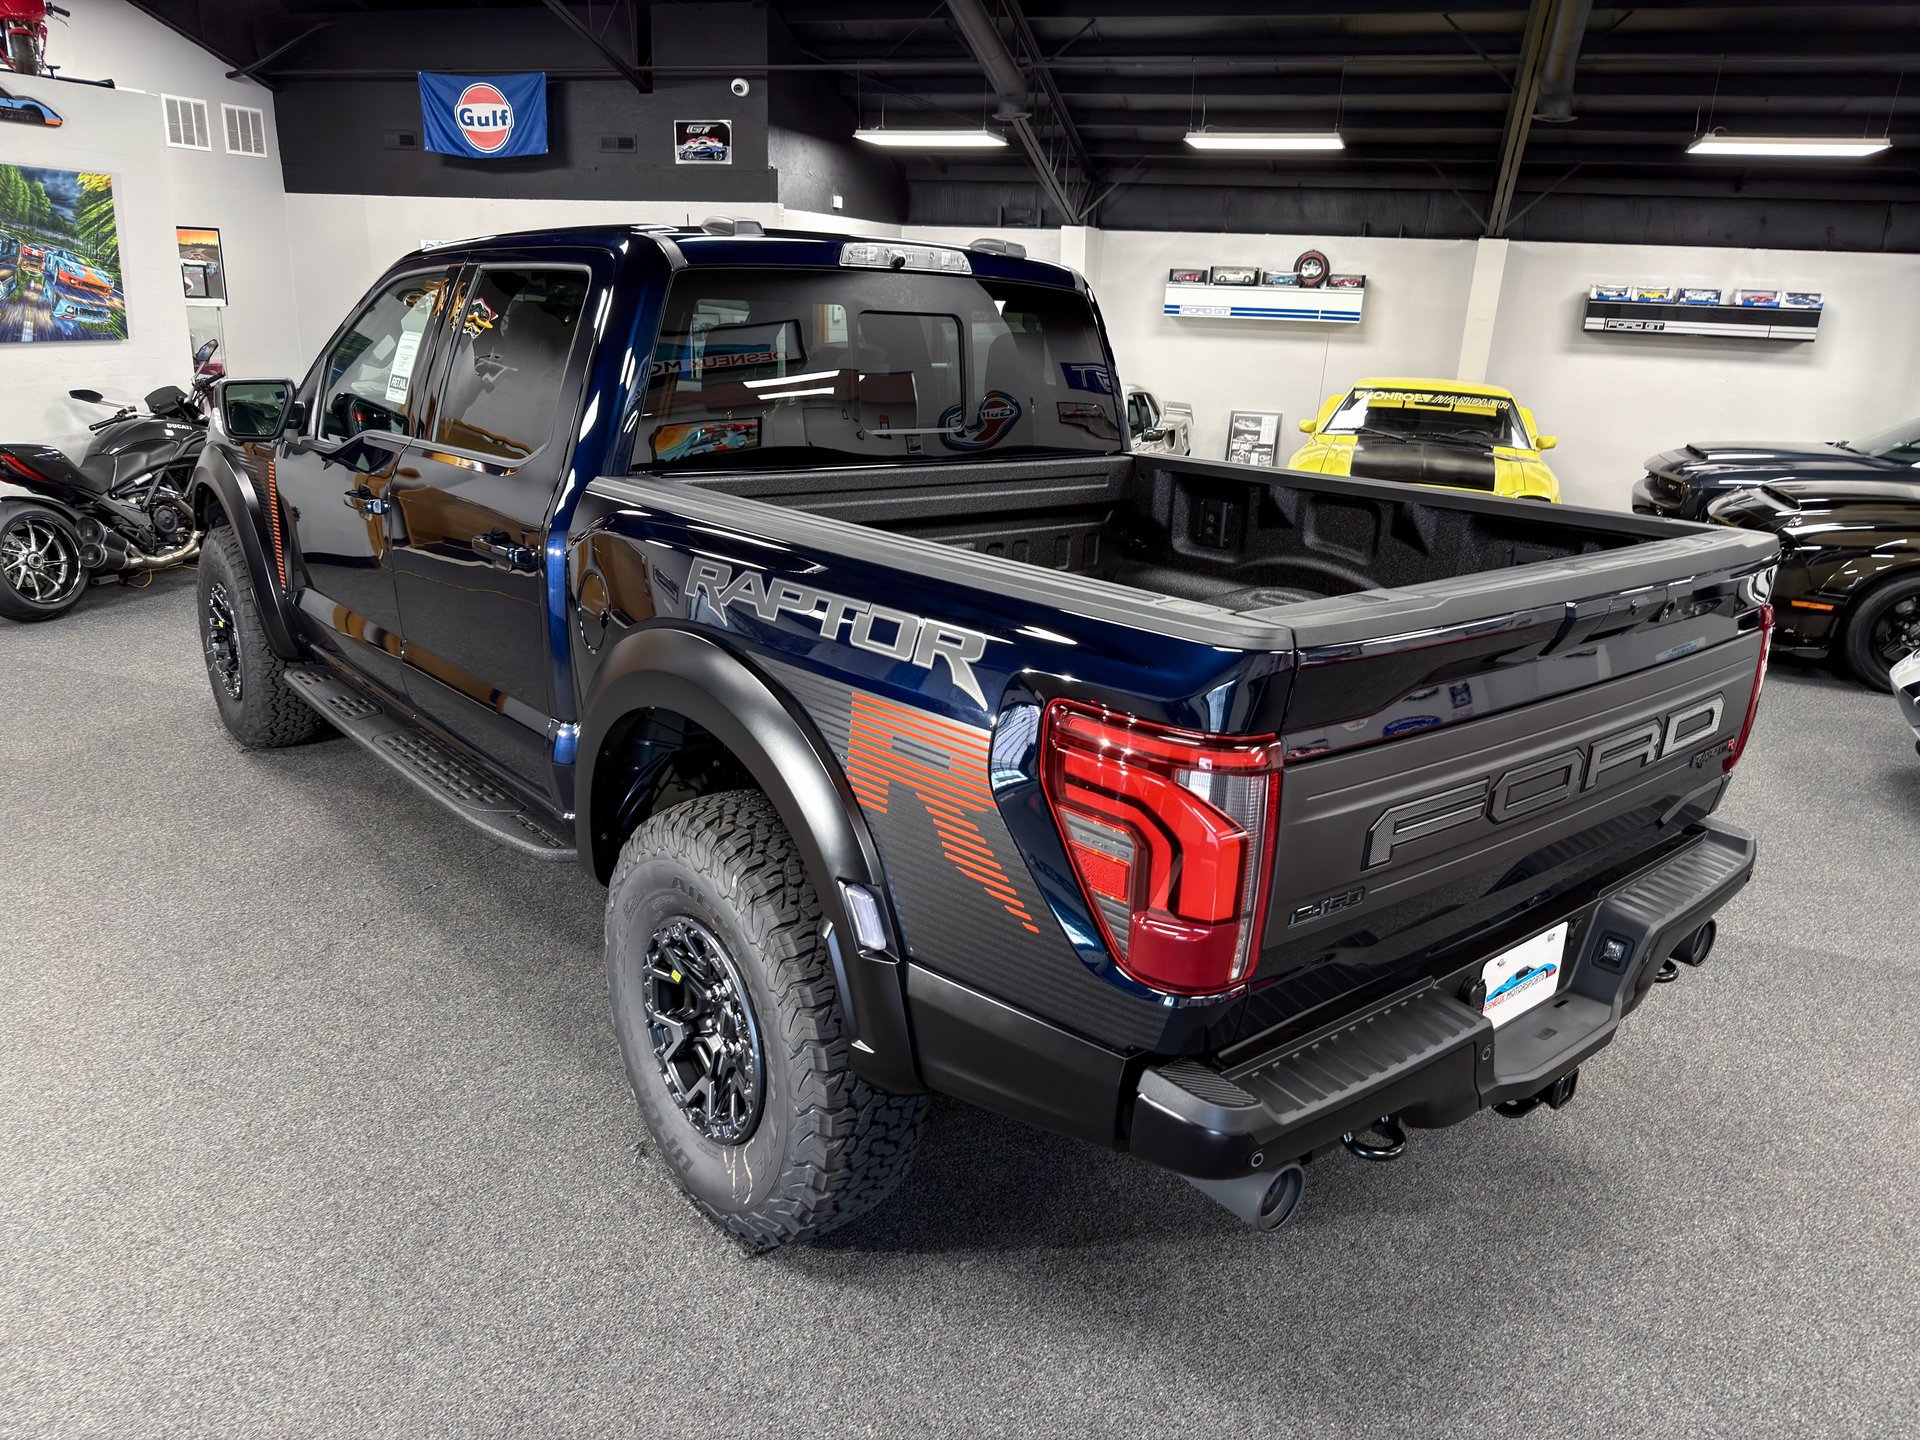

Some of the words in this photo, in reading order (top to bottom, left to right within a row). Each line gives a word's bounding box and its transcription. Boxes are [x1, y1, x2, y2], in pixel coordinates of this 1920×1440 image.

[460, 108, 508, 127] Gulf
[1607, 320, 1643, 329] FORD
[1645, 322, 1664, 331] GT
[1367, 391, 1424, 402] MONROE
[166, 422, 193, 430] DUCATI
[684, 556, 988, 712] RAPTOR
[1362, 692, 1727, 871] FORD
[1484, 994, 1505, 1012] ESNEUX
[1505, 972, 1546, 1000] MOTORSPORTS
